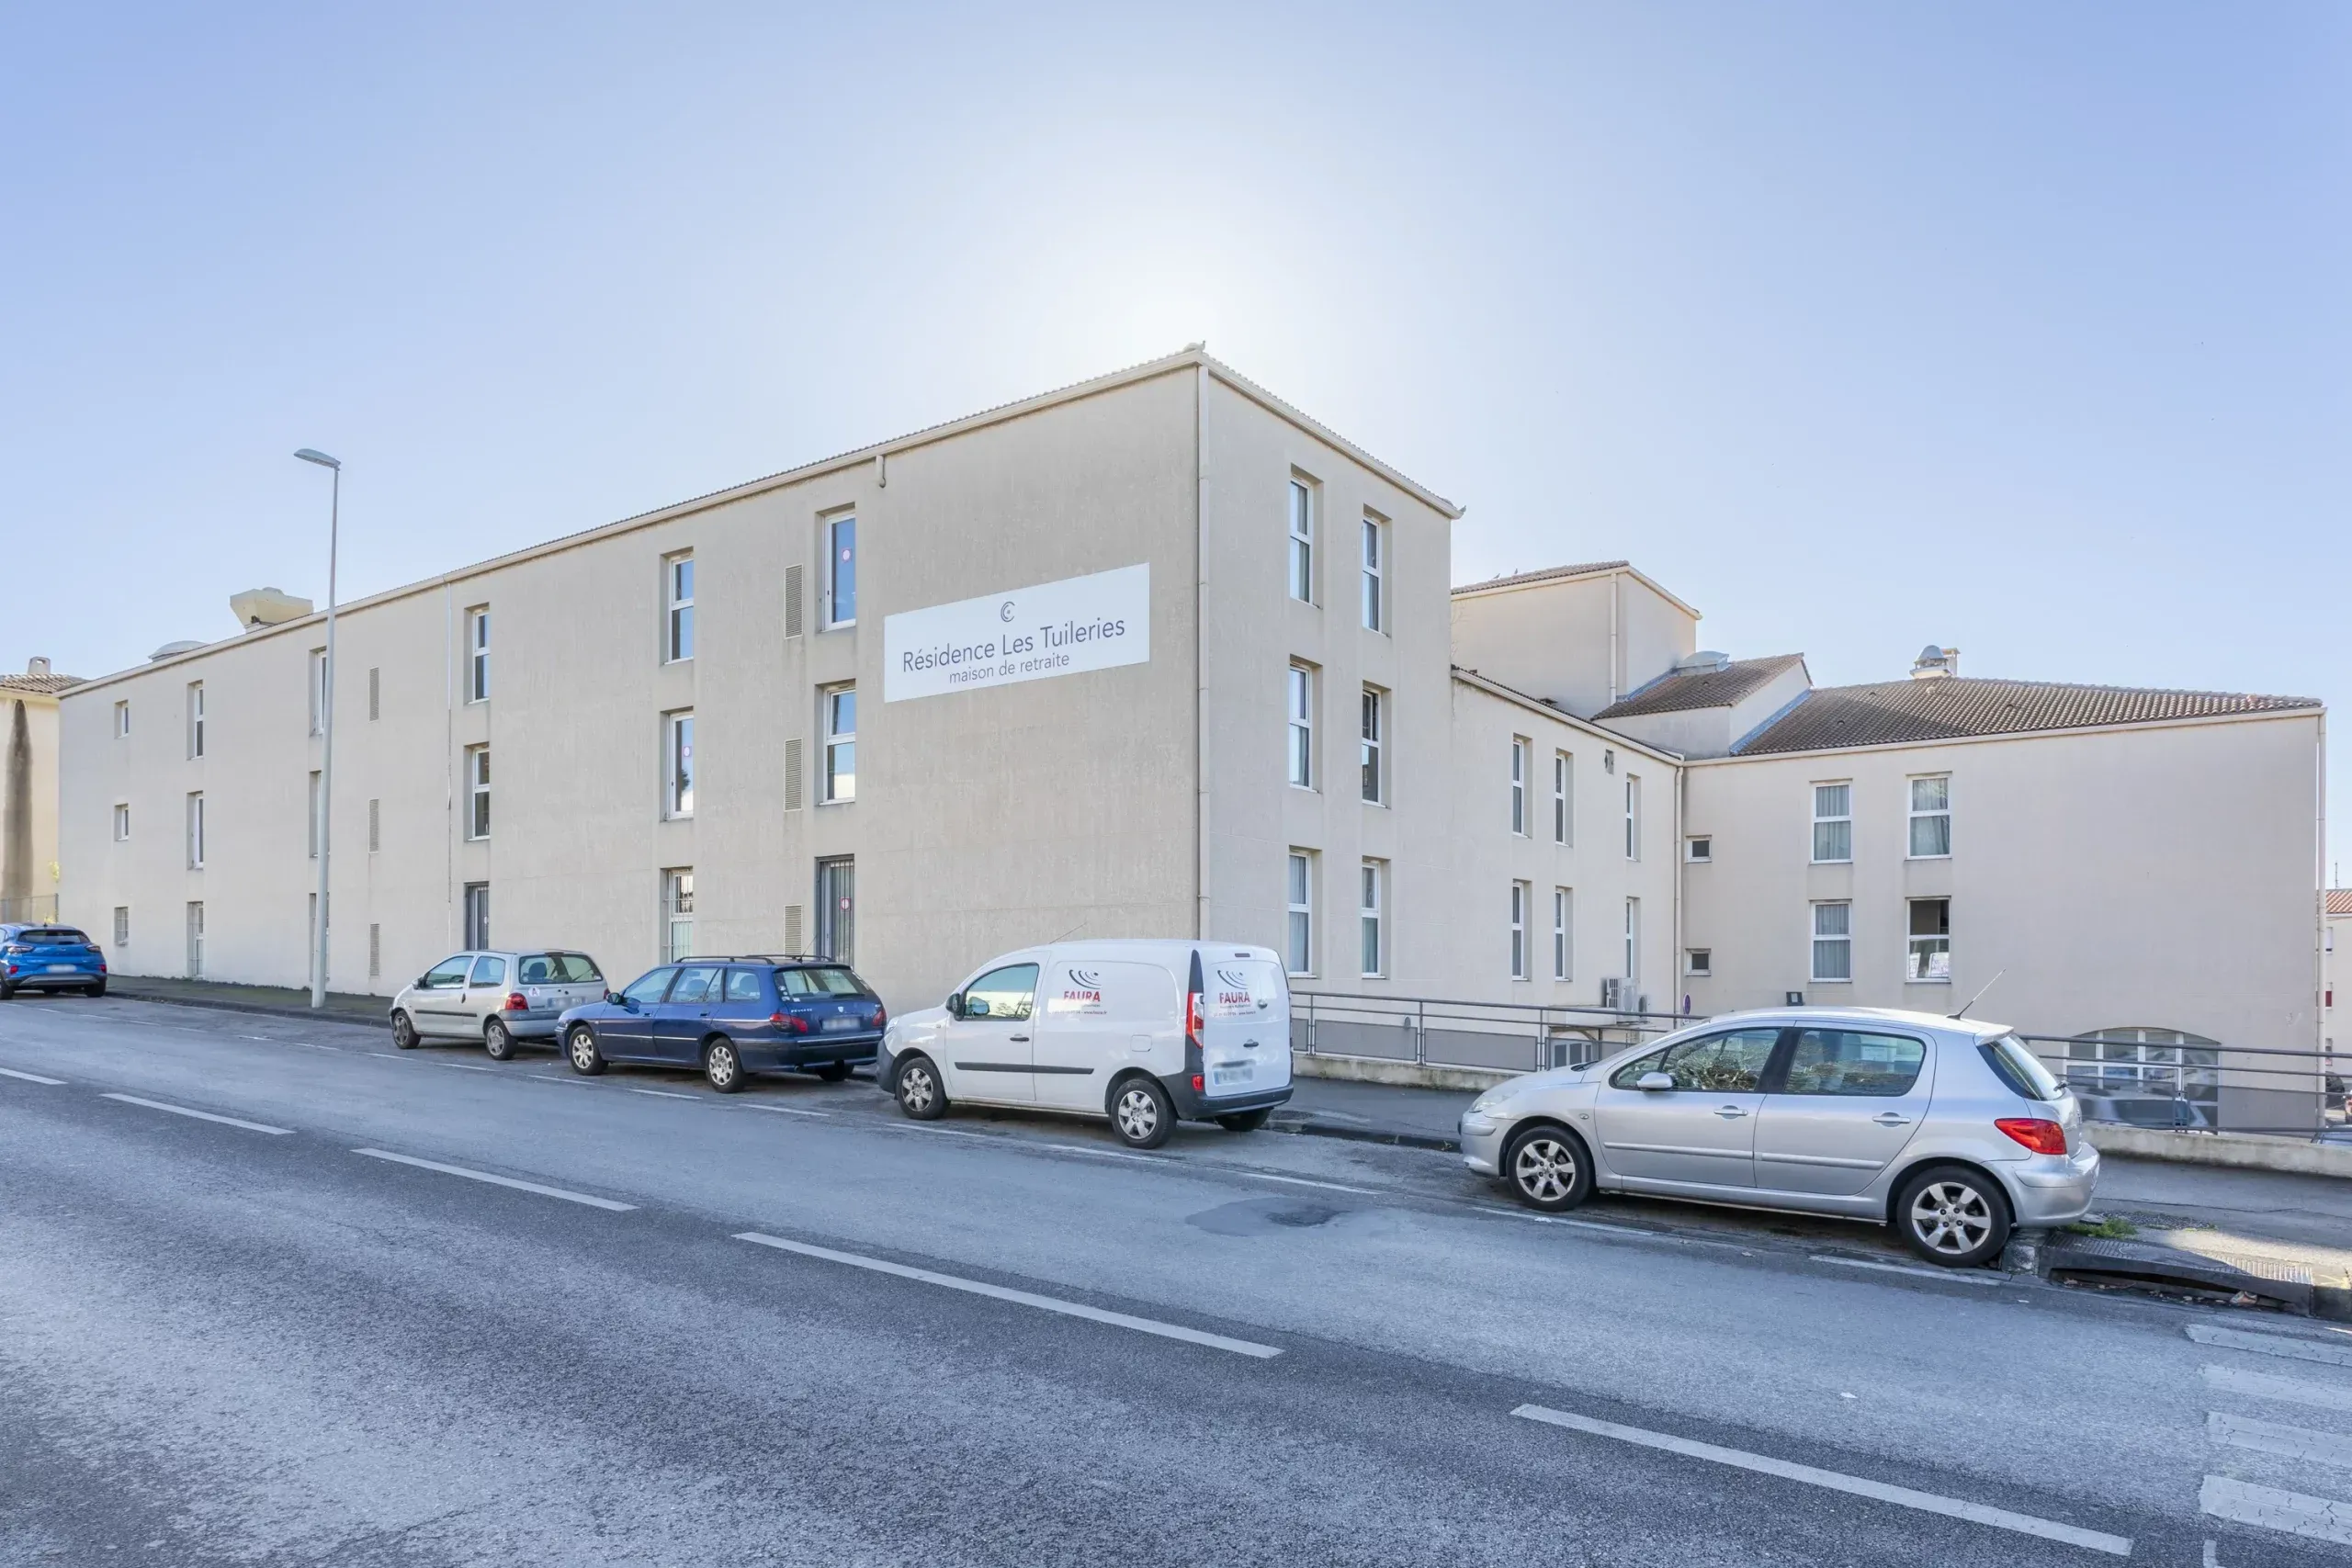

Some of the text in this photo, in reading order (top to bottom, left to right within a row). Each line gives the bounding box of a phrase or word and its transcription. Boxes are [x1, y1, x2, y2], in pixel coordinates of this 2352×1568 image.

[902, 617, 1125, 673] Résidence Les Tuileries
[949, 651, 1070, 684] maison de retraite
[1063, 990, 1101, 1002] FAURA
[1219, 991, 1250, 1003] FAURA
